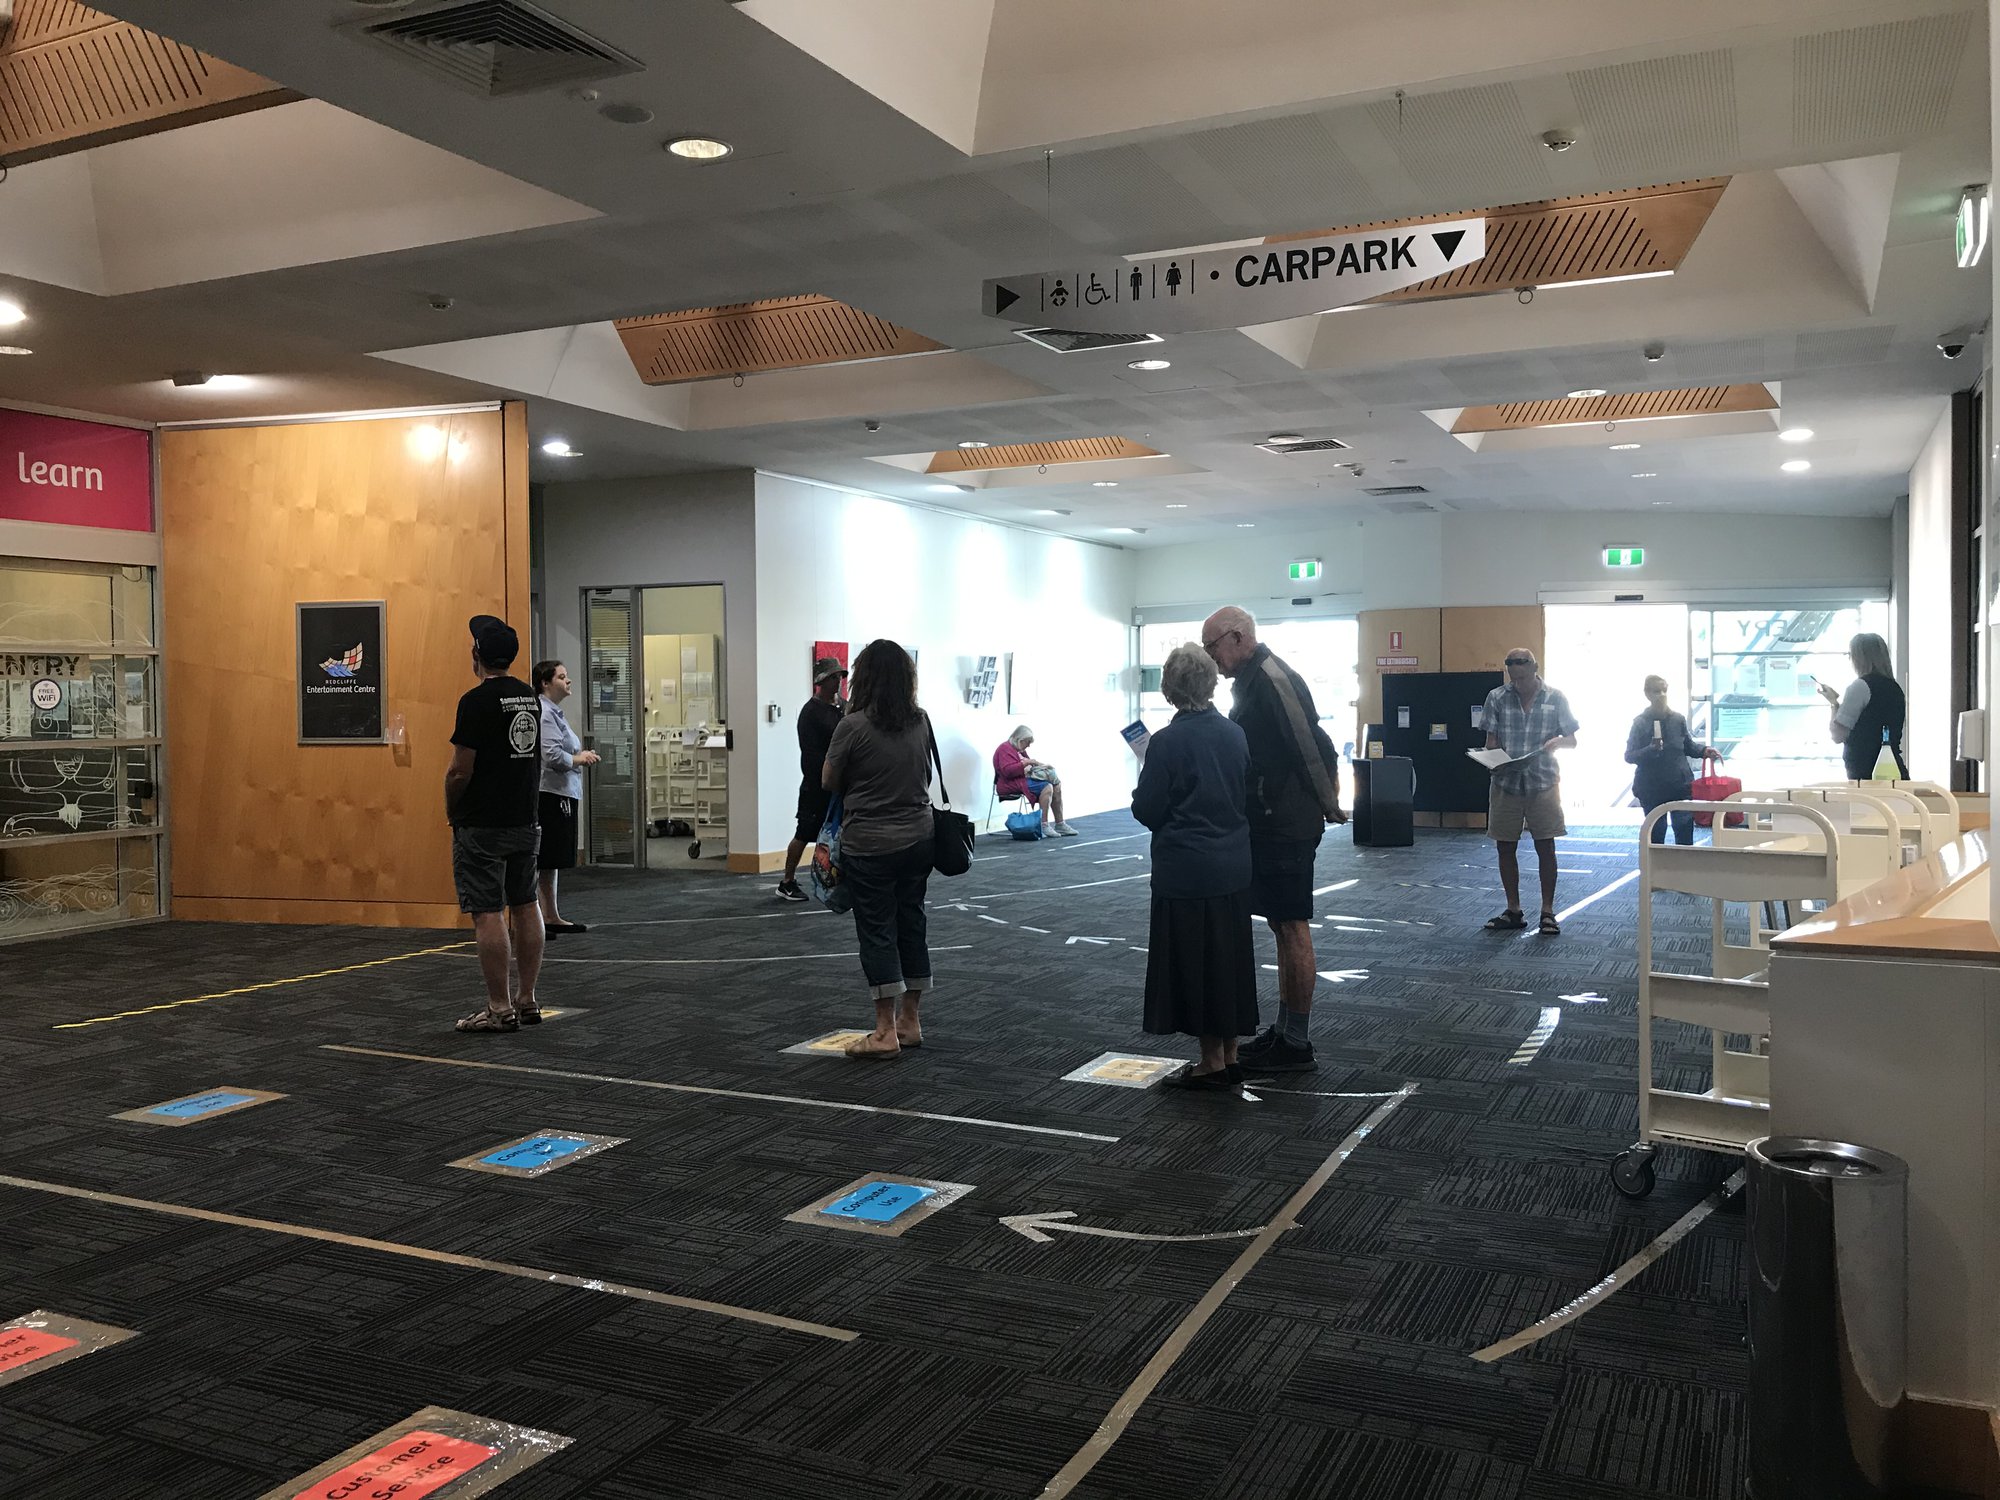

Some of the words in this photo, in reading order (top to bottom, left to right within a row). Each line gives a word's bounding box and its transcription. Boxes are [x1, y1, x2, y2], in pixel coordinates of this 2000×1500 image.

[1235, 235, 1417, 287] CARPARK
[18, 451, 103, 491] learn
[306, 685, 353, 694] Entertainment
[353, 685, 376, 693] Centre
[164, 1093, 225, 1113] Computer
[842, 1184, 892, 1212] Computer
[877, 1195, 902, 1207] Use
[326, 1440, 432, 1500] Customer
[372, 1455, 454, 1500] Service
